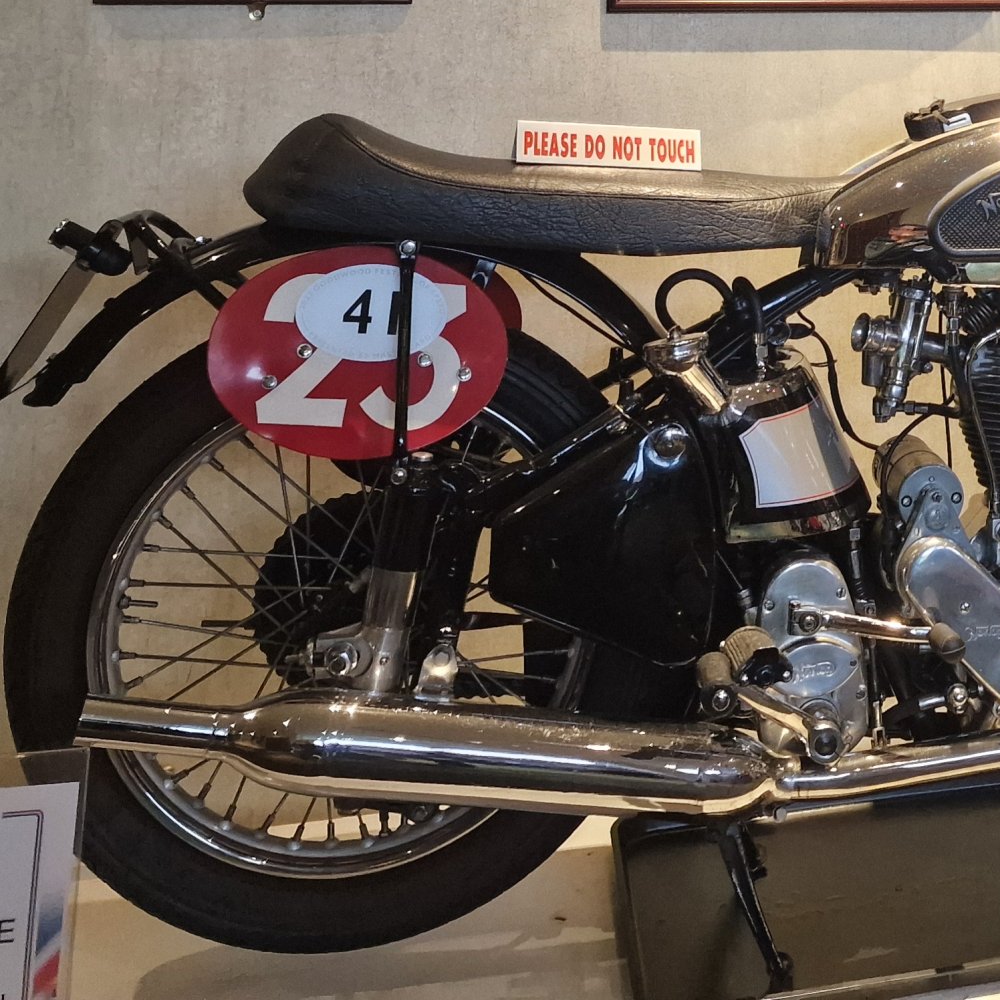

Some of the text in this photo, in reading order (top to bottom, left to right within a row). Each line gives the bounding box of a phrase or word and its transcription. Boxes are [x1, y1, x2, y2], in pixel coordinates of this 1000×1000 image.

[523, 131, 695, 163] PLEASE DO NOT TOUCH
